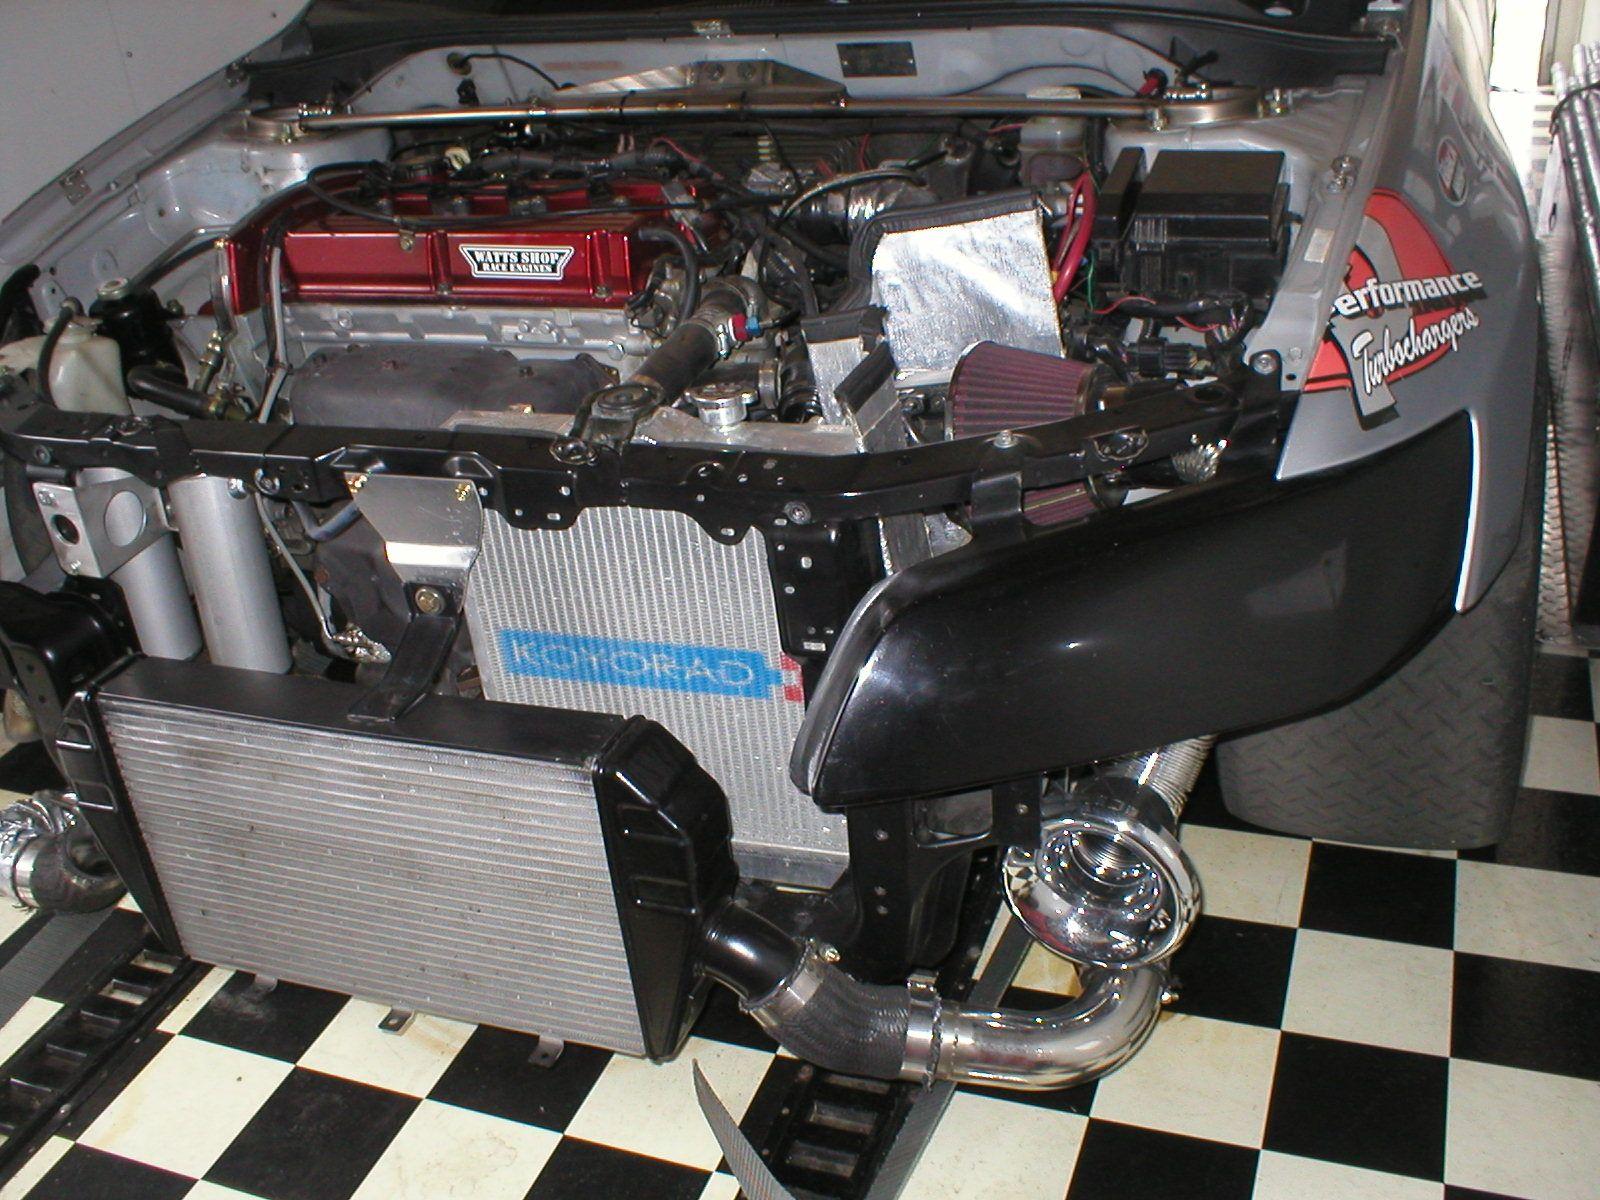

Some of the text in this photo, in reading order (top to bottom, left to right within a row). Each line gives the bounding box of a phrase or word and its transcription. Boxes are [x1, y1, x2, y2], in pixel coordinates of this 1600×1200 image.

[474, 250, 559, 264] WATTS SHOP
[1332, 270, 1483, 316] erformance
[1352, 306, 1480, 395] Turbochargers
